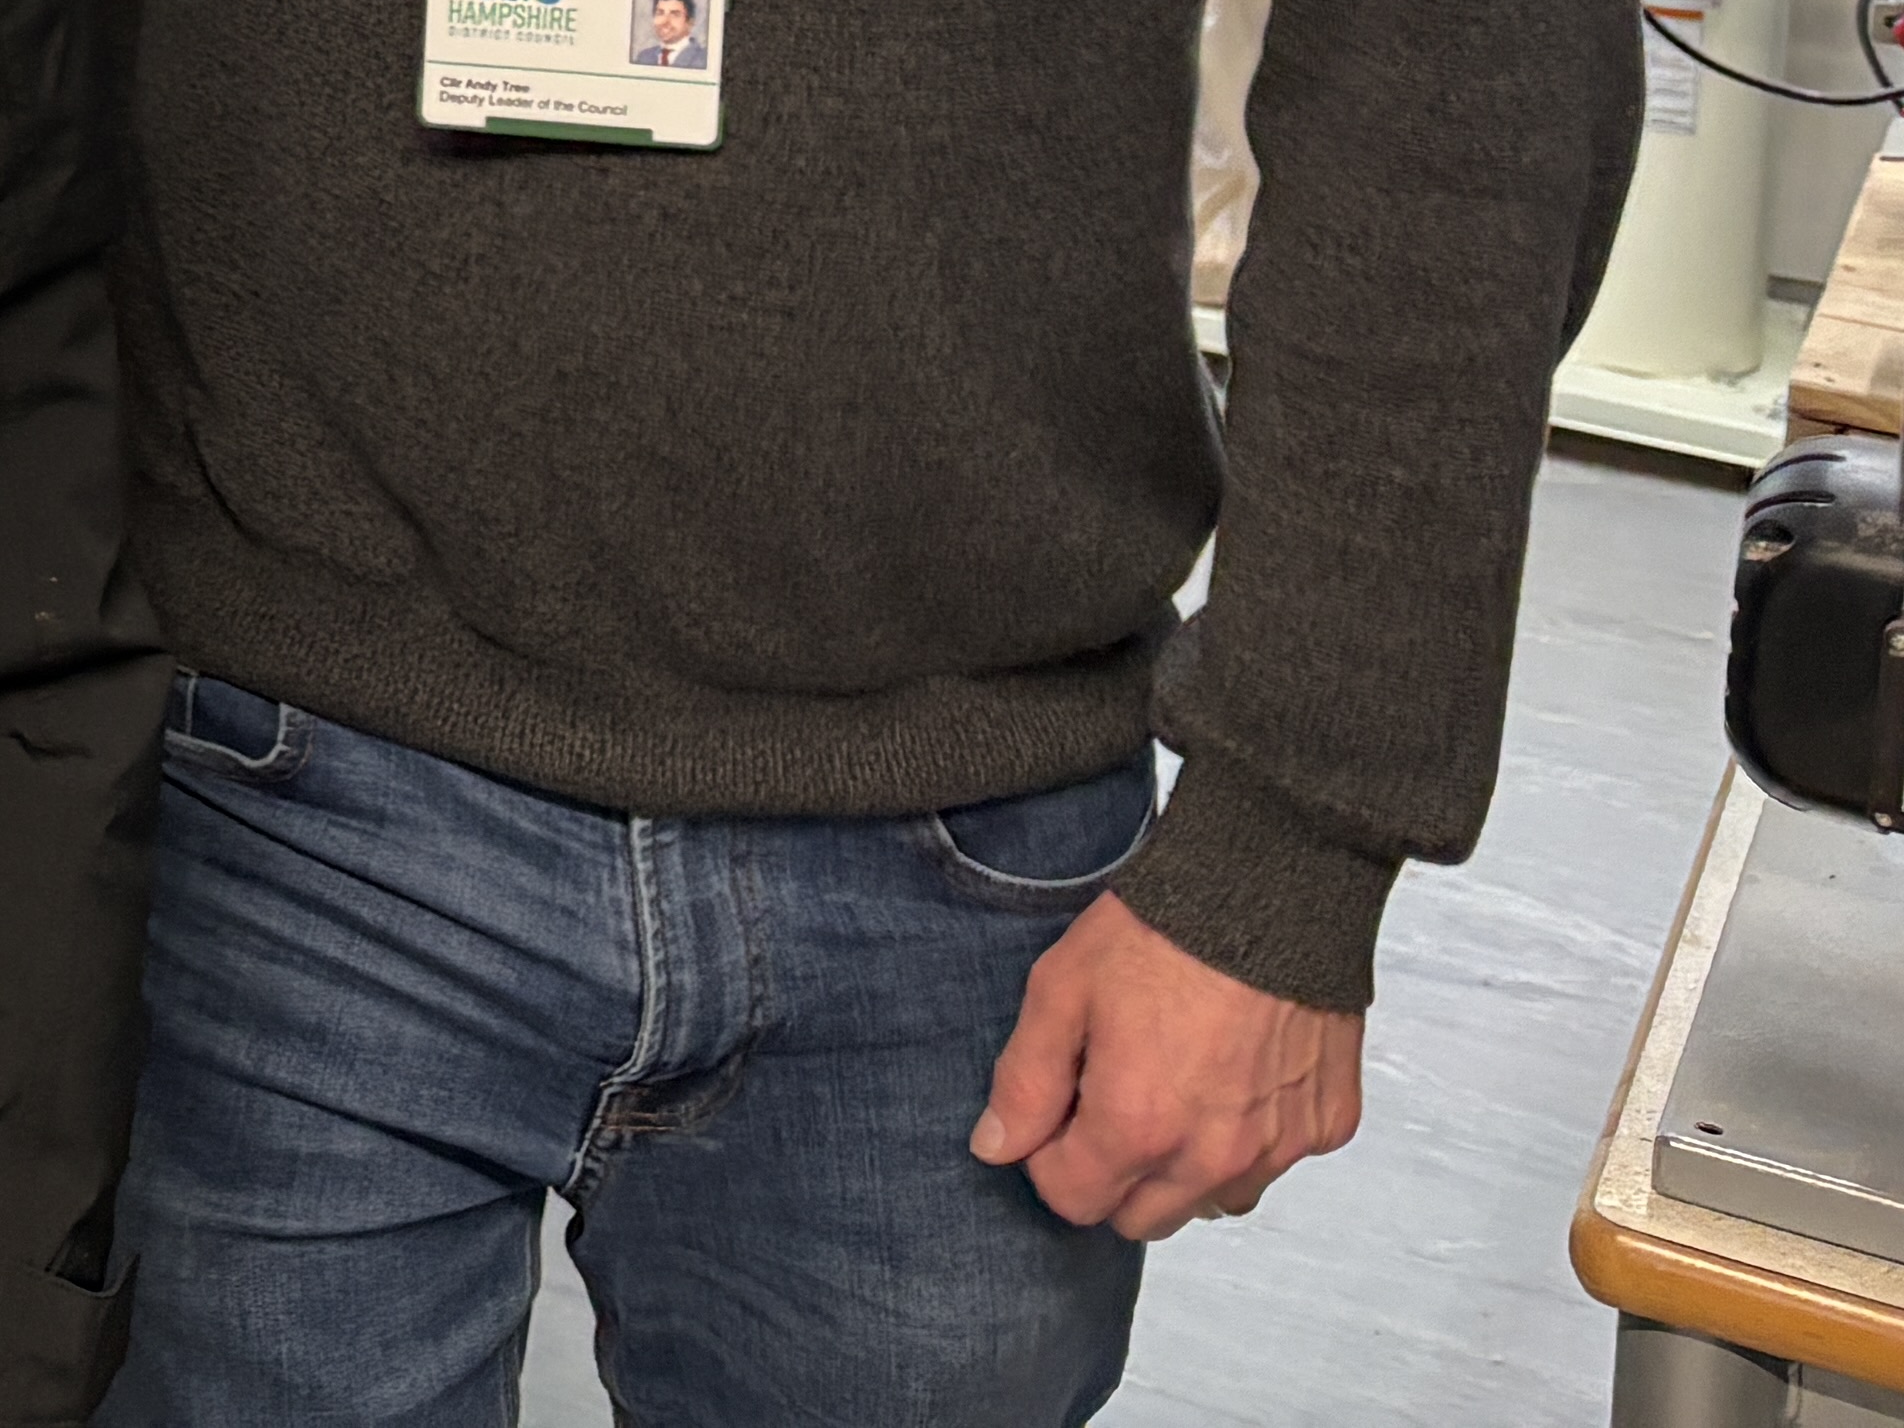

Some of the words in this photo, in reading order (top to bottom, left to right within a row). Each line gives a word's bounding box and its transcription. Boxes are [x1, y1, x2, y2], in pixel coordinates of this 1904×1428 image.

[448, 0, 578, 32] HAMPSHIRE
[448, 25, 510, 41] DISTRICT
[516, 30, 575, 46] COUNCIL
[465, 78, 499, 94] Andy
[502, 80, 531, 93] Tree
[439, 89, 486, 108] Deputy
[488, 94, 534, 109] Leader
[537, 99, 551, 110] of
[553, 99, 574, 112] the
[577, 100, 628, 116] Council
